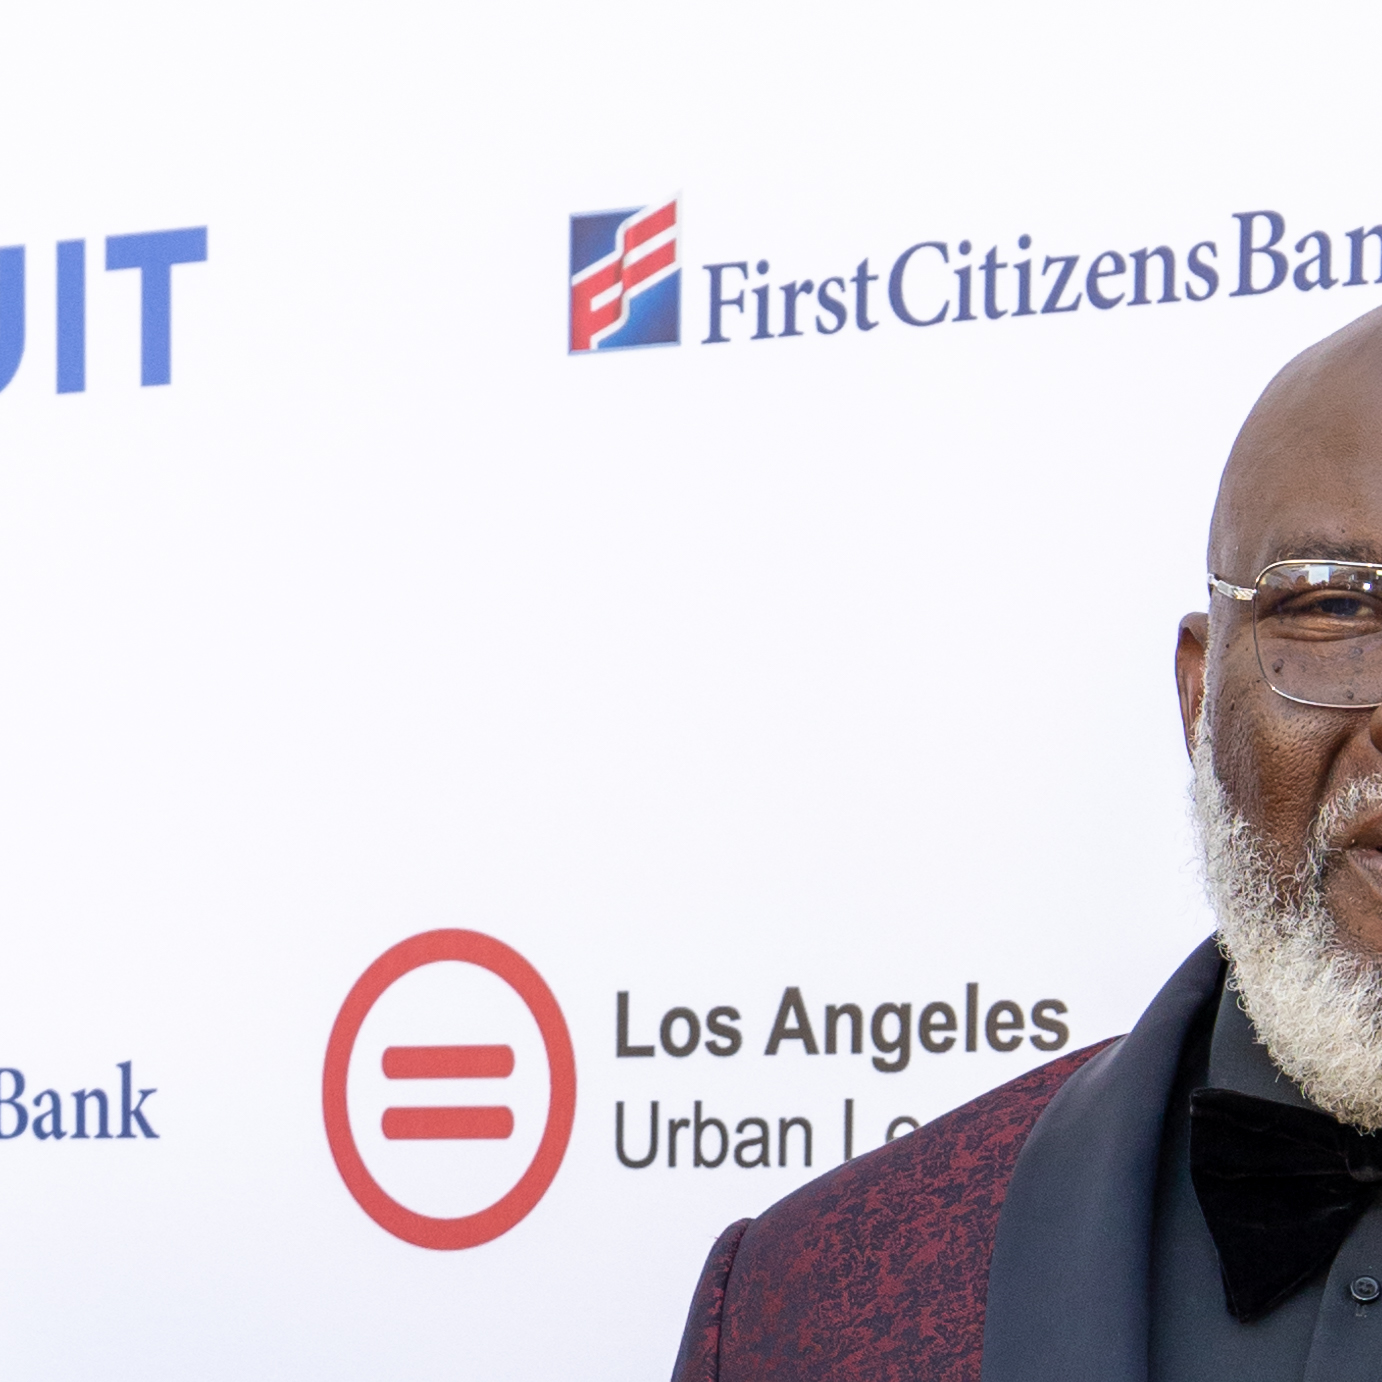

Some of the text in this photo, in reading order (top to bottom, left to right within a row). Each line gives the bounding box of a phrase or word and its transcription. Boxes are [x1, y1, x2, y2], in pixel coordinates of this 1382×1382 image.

[616, 982, 1071, 1074] Los Angeles
[615, 1099, 814, 1170] Urban
